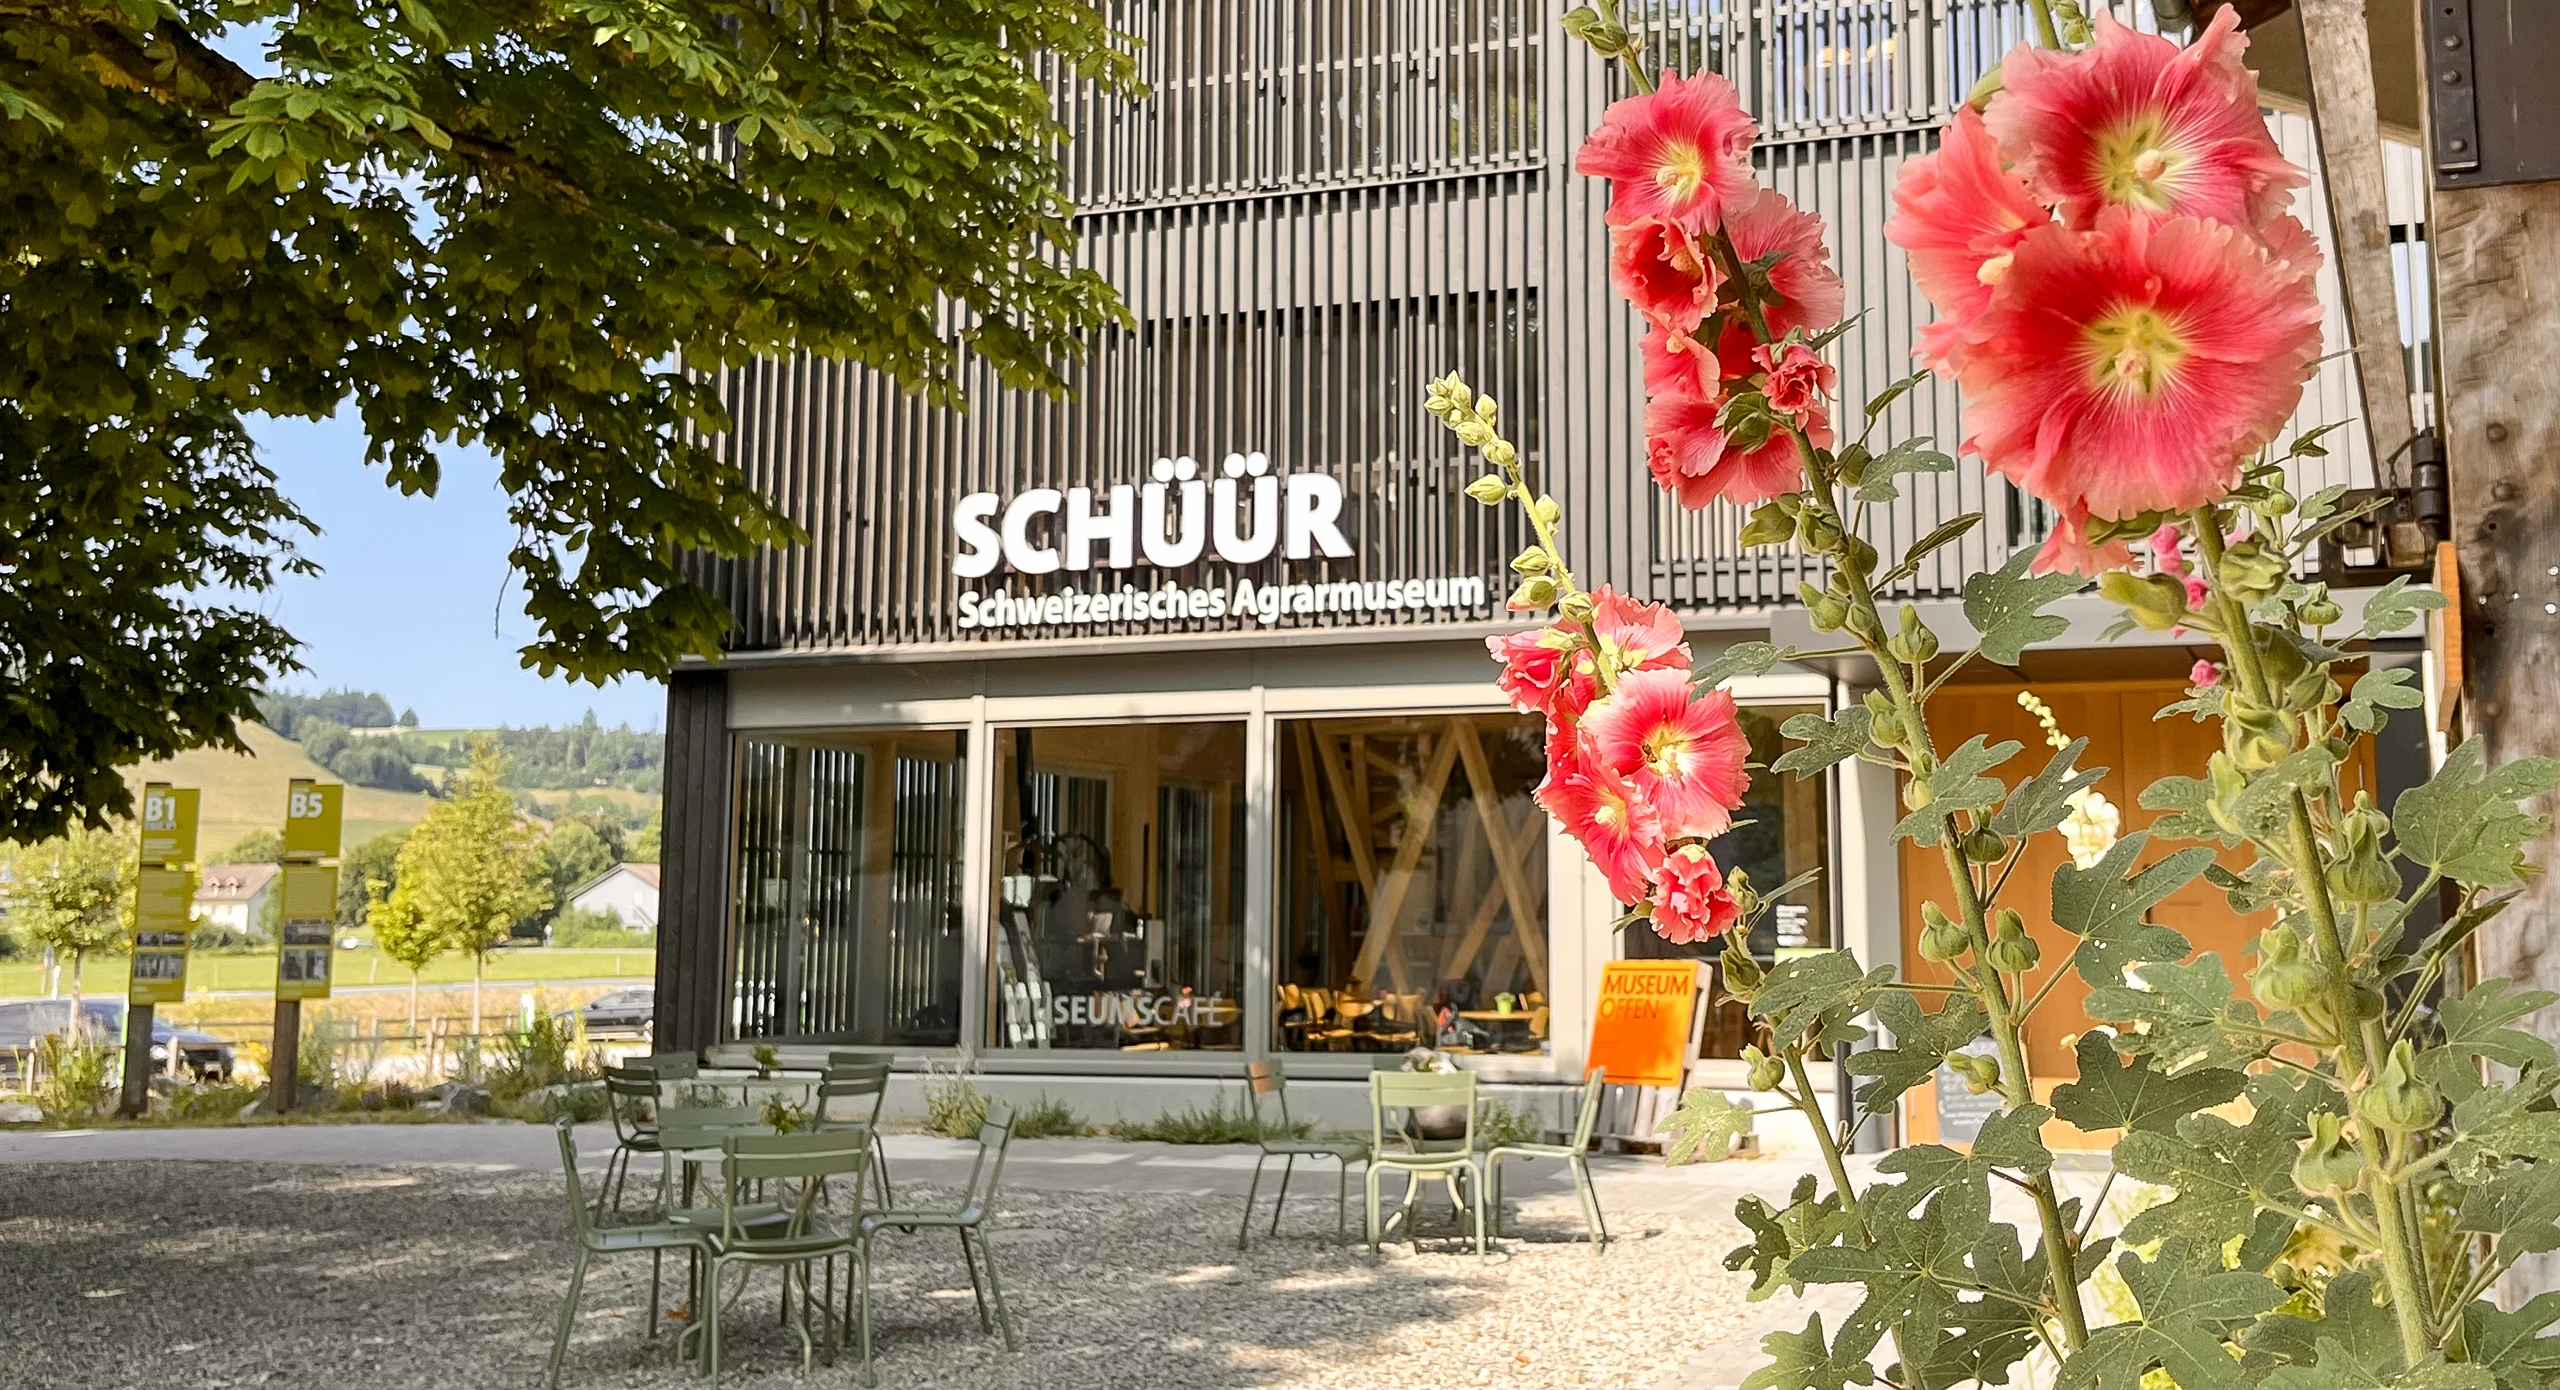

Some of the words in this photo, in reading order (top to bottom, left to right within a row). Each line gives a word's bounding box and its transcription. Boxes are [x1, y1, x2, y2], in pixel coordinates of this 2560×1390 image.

[952, 452, 1355, 578] SCHÜÜR
[958, 581, 1225, 628] Schweizerisches
[1232, 576, 1484, 625] Agrarmuseum
[145, 797, 176, 822] B1
[290, 792, 323, 818] B5
[1603, 974, 1688, 996] MUSEUM
[1600, 997, 1659, 1019] OFFEN
